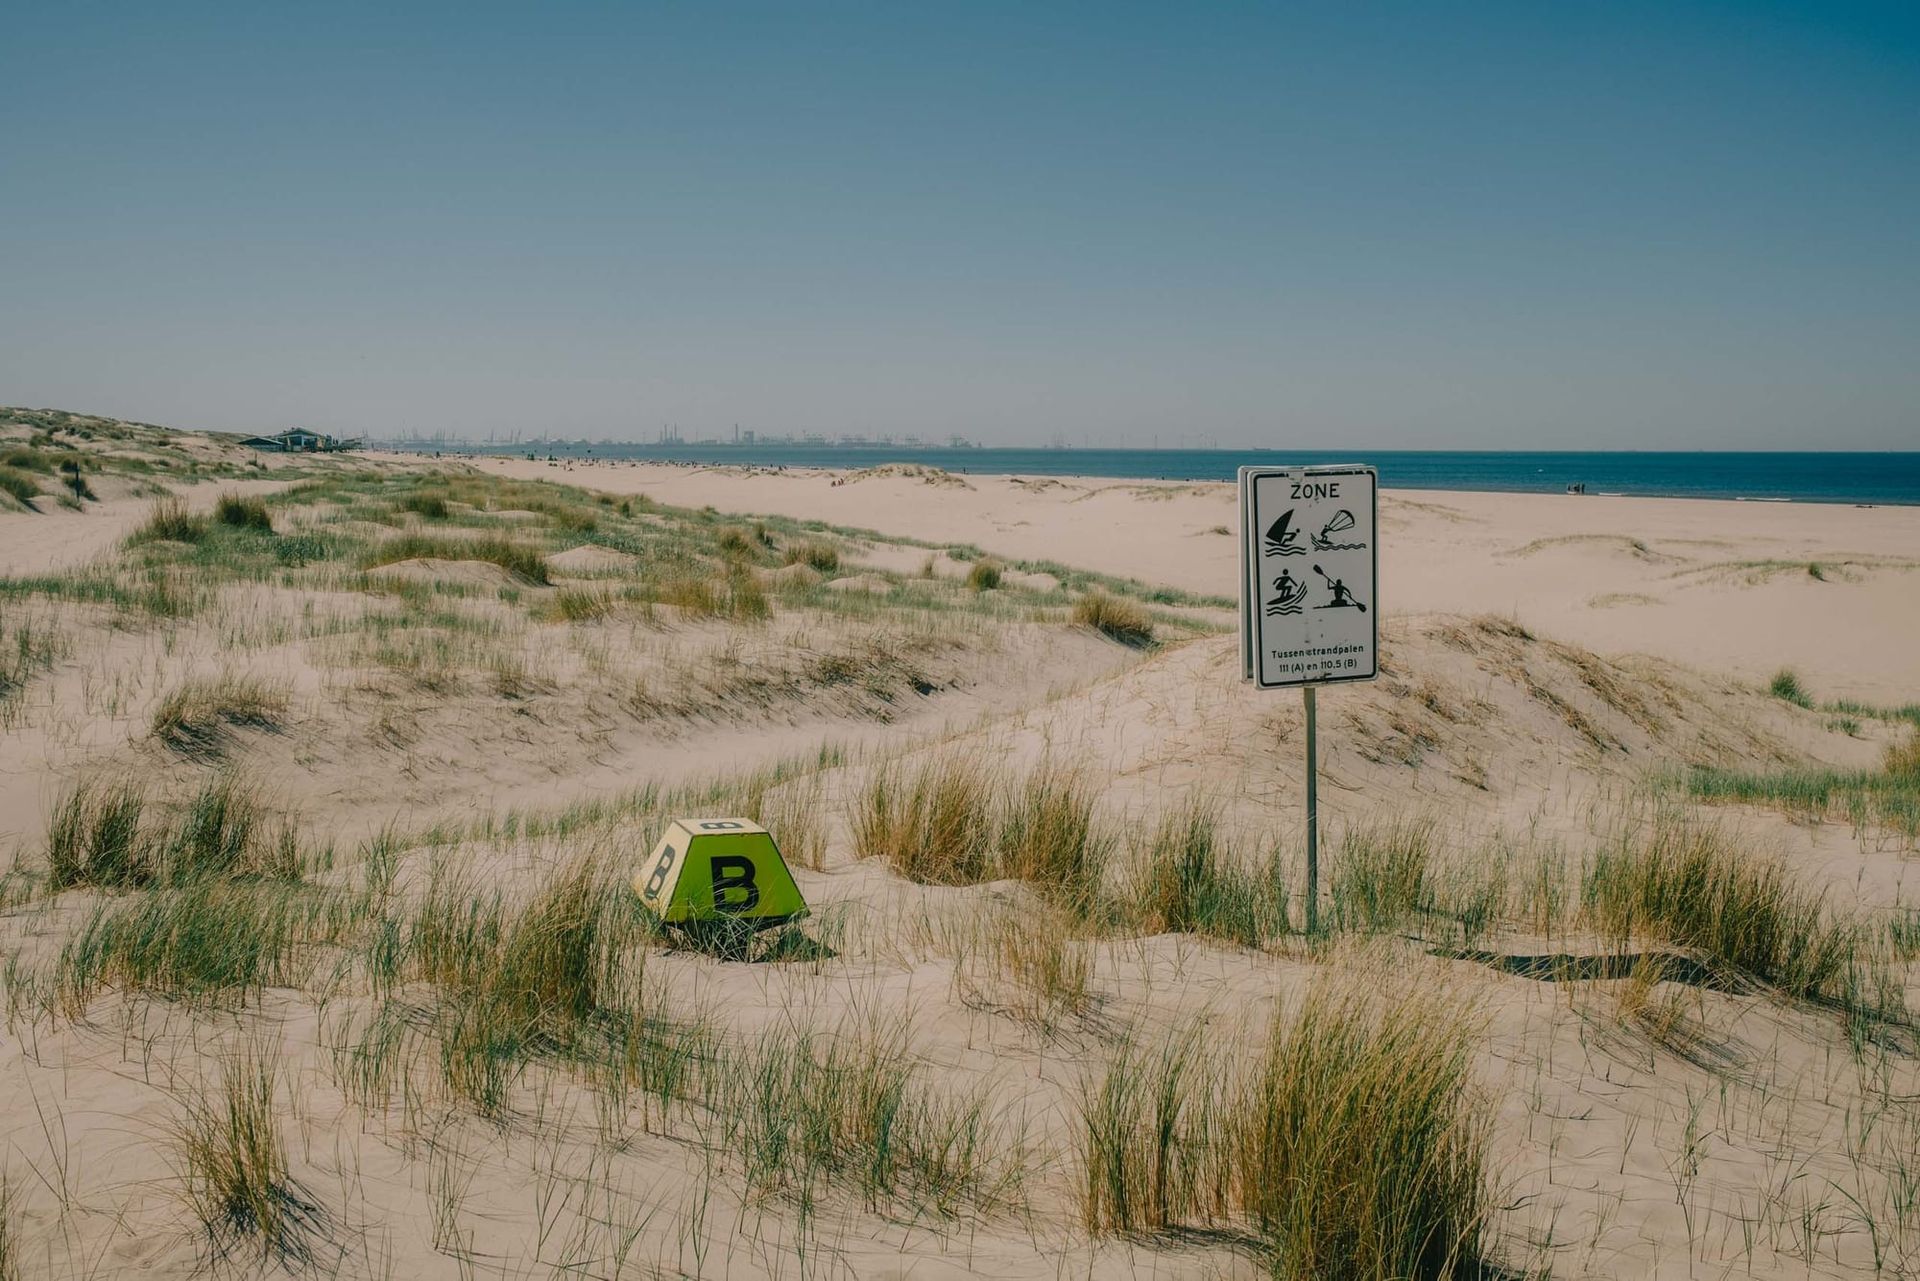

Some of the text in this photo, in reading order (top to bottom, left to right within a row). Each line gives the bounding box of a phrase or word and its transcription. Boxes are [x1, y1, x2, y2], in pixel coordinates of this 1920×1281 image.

[1290, 483, 1340, 499] ZONE
[1272, 645, 1364, 658] Tussen strandpalen
[1280, 664, 1289, 672] 111
[1291, 663, 1304, 673] (A)
[1320, 660, 1341, 669] 110.5
[1344, 659, 1357, 669] (B)
[644, 844, 676, 900] B
[710, 855, 759, 912] B
